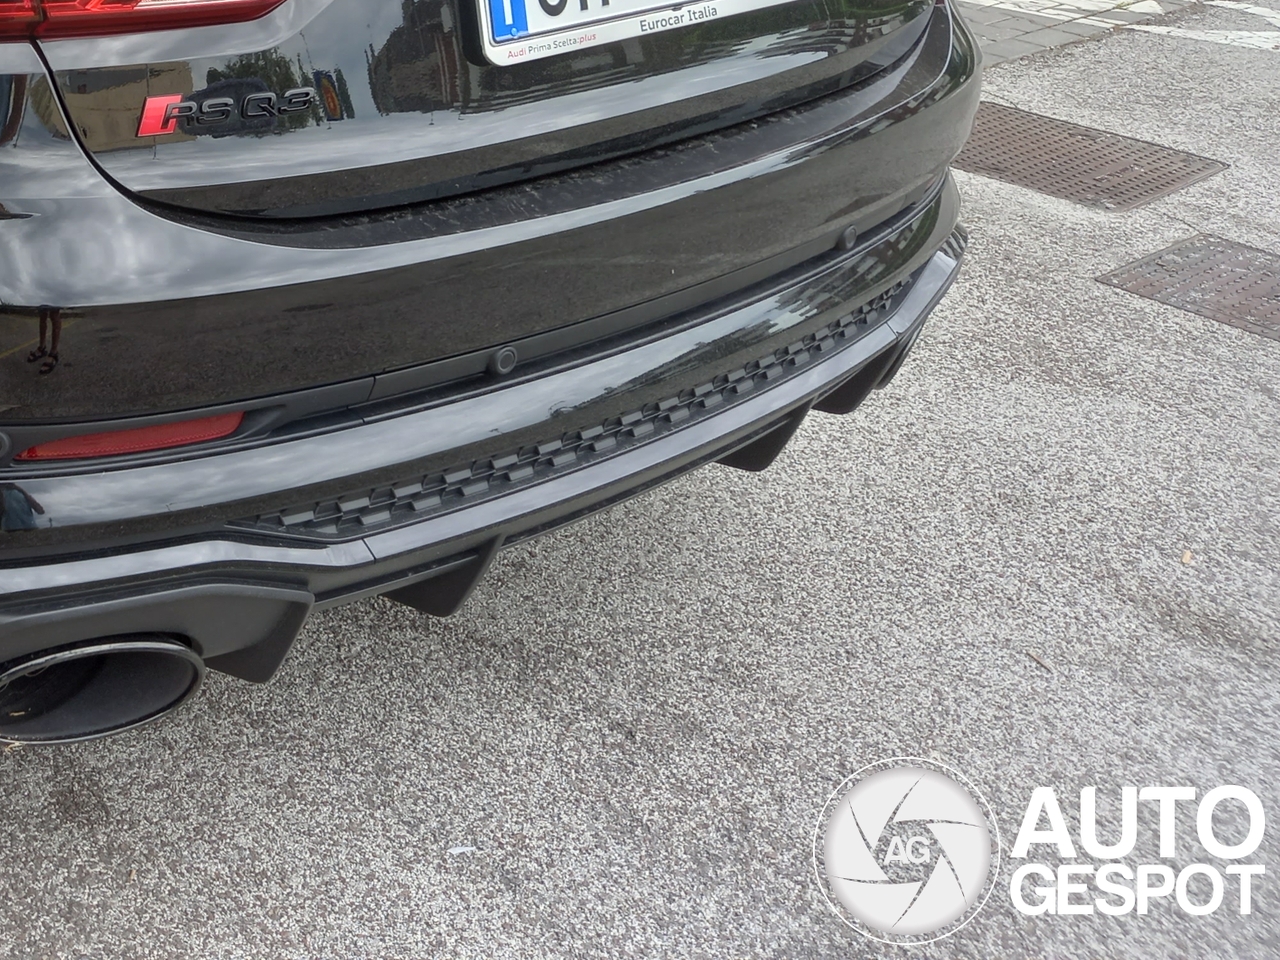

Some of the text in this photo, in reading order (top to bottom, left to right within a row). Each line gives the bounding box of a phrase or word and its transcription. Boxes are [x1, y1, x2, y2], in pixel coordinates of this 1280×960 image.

[640, 5, 718, 32] Eurocar Italia
[507, 48, 527, 59] Audi
[528, 43, 552, 54] Prima
[161, 86, 316, 130] RS Q3
